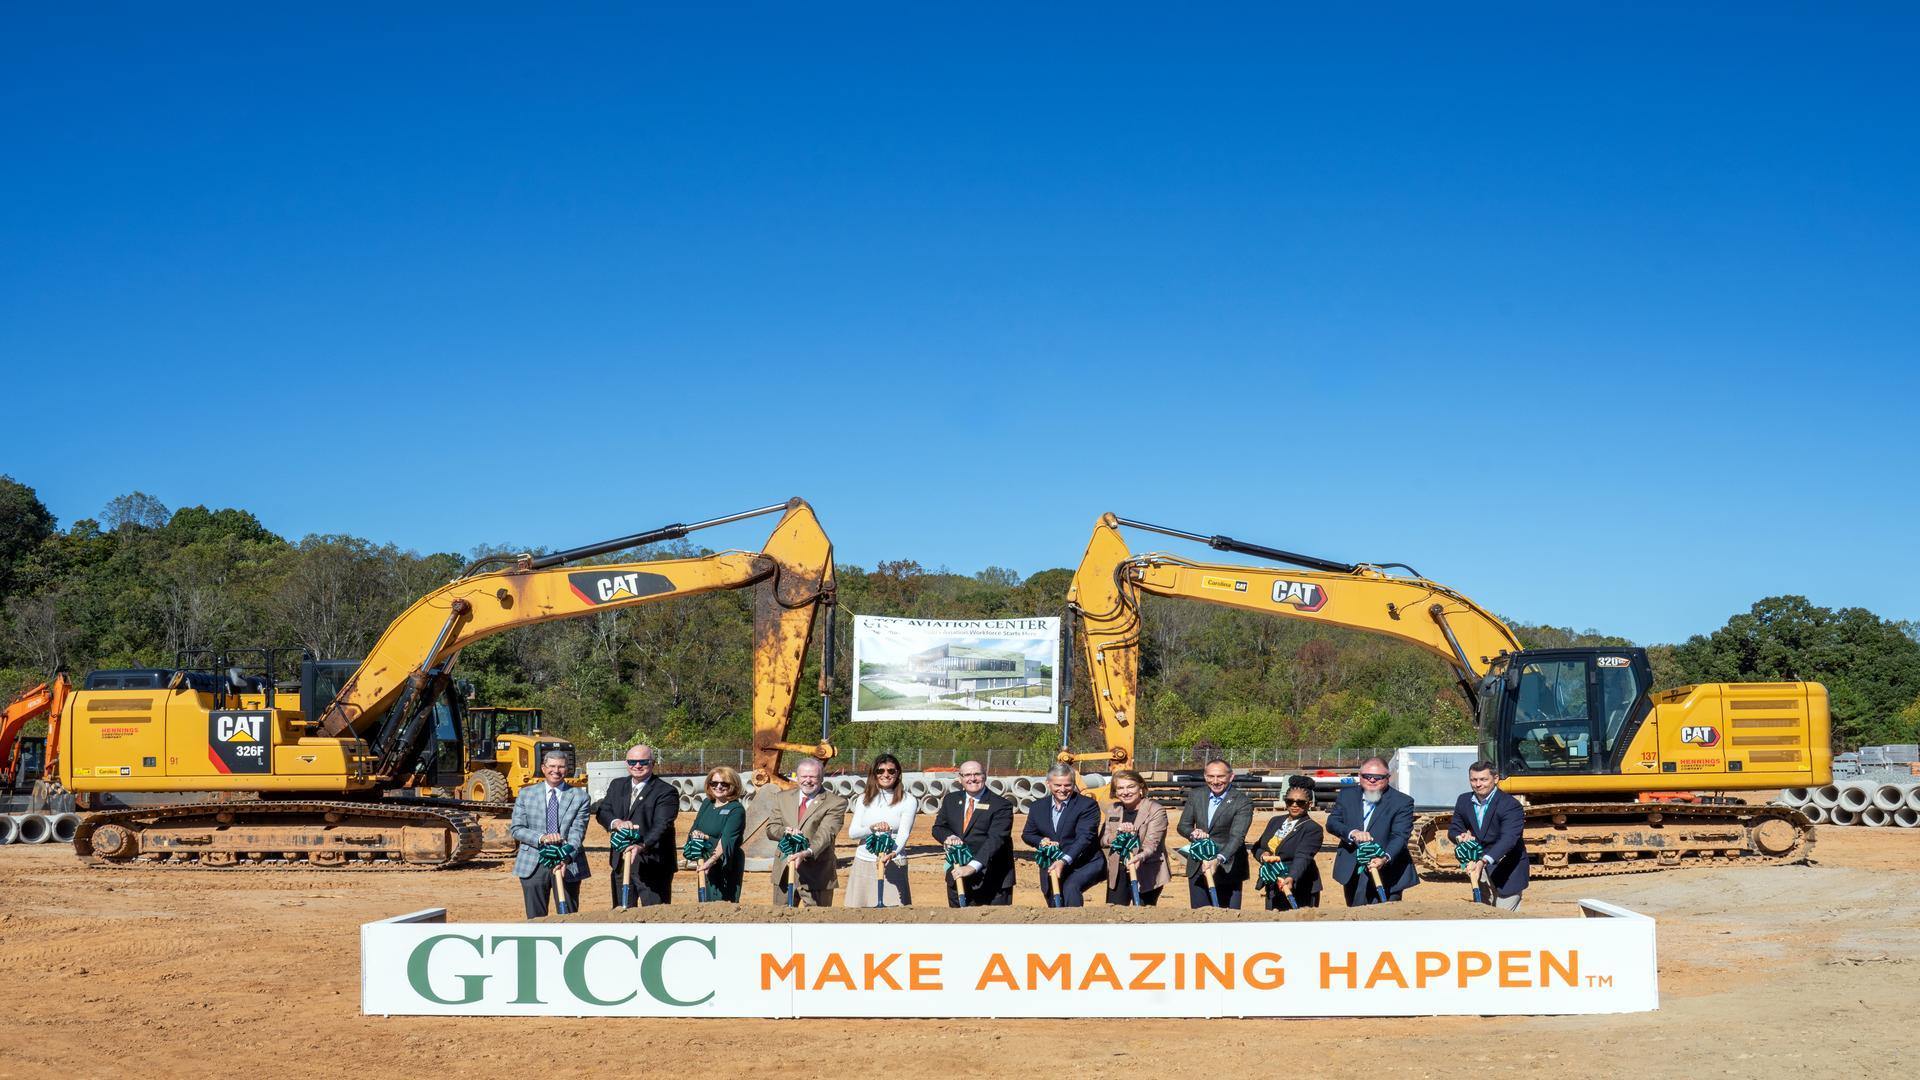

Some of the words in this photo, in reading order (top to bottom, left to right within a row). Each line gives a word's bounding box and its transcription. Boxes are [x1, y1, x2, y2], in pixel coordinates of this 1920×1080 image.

[597, 573, 639, 601] CAT
[1235, 582, 1246, 590] CAT
[1272, 580, 1316, 605] CAT
[908, 619, 981, 629] AVIATION
[984, 619, 1048, 630] CENTER
[217, 716, 264, 742] CAT
[1681, 727, 1711, 743] CAT
[236, 745, 264, 757] 326F
[1641, 752, 1657, 761] 137
[407, 934, 716, 1006] GTCC
[760, 953, 943, 991] MAKE
[975, 951, 1286, 991] AMAZING
[1319, 949, 1579, 990] HAPPEN
